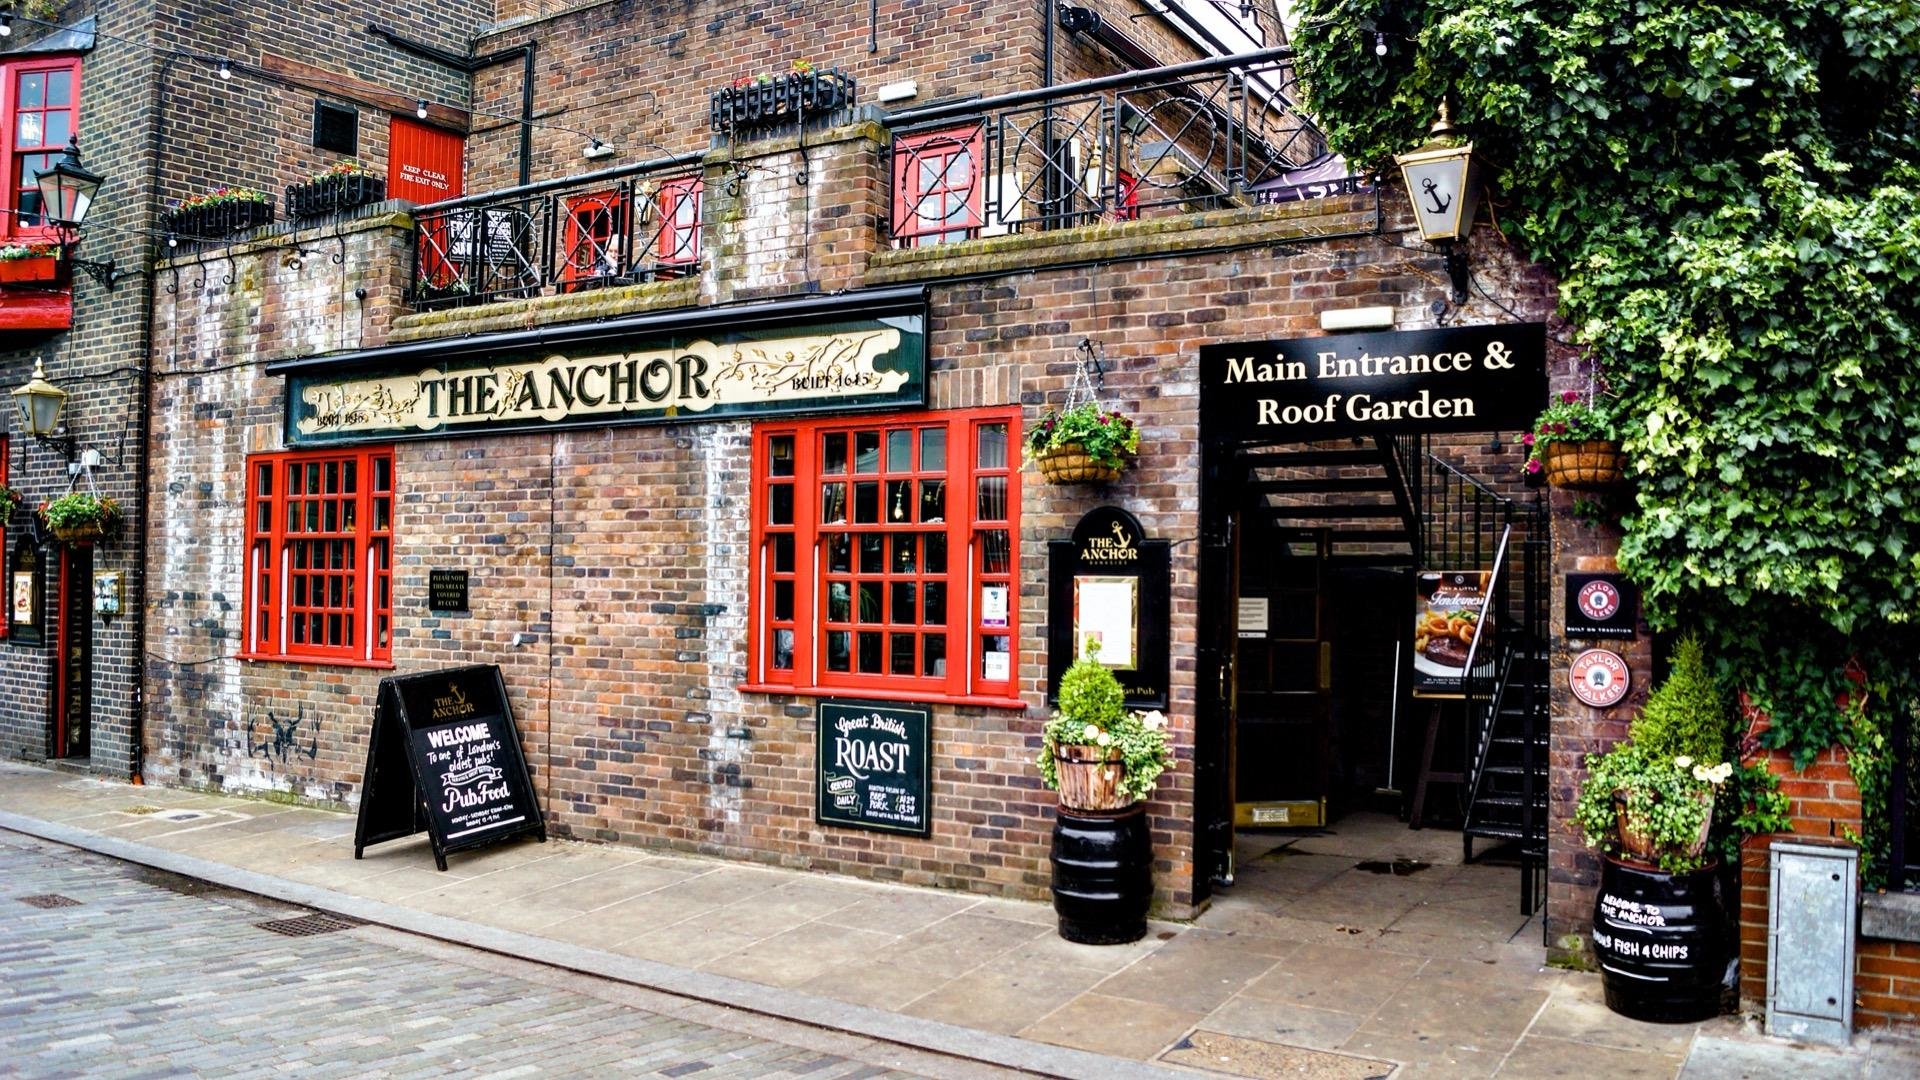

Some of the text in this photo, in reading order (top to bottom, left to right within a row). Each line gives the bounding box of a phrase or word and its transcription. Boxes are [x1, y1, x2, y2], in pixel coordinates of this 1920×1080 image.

[400, 173, 449, 190] FIRE EXIT ONLY
[403, 164, 447, 182] KEEP CLEAR
[1224, 340, 1516, 385] Main Entrance &
[420, 353, 711, 419] THE ANCHOR
[1257, 389, 1476, 426] Roof Garden
[1088, 537, 1113, 548] THE
[1080, 548, 1138, 560] ANCHOR
[1582, 583, 1615, 596] TAYLOR
[1583, 602, 1615, 617] WALKER
[1579, 654, 1619, 671] TAYLOR
[1579, 682, 1621, 701] WALKER
[432, 702, 475, 719] ANCHOR
[435, 696, 453, 707] THE
[835, 713, 908, 740] Great British
[427, 723, 491, 749] WELCOME
[426, 740, 501, 765] To one of London's
[835, 737, 910, 780] ROAST
[449, 756, 472, 772] oldest
[830, 780, 853, 791] SERVED
[442, 780, 511, 813] Pub Food
[836, 794, 856, 806] DAILY
[869, 800, 890, 811] PORK
[1603, 893, 1660, 916] WELCOME TO
[1600, 902, 1666, 927] THE ANCHOR
[1614, 938, 1640, 956] FISH
[1652, 943, 1688, 960] CHIPS
